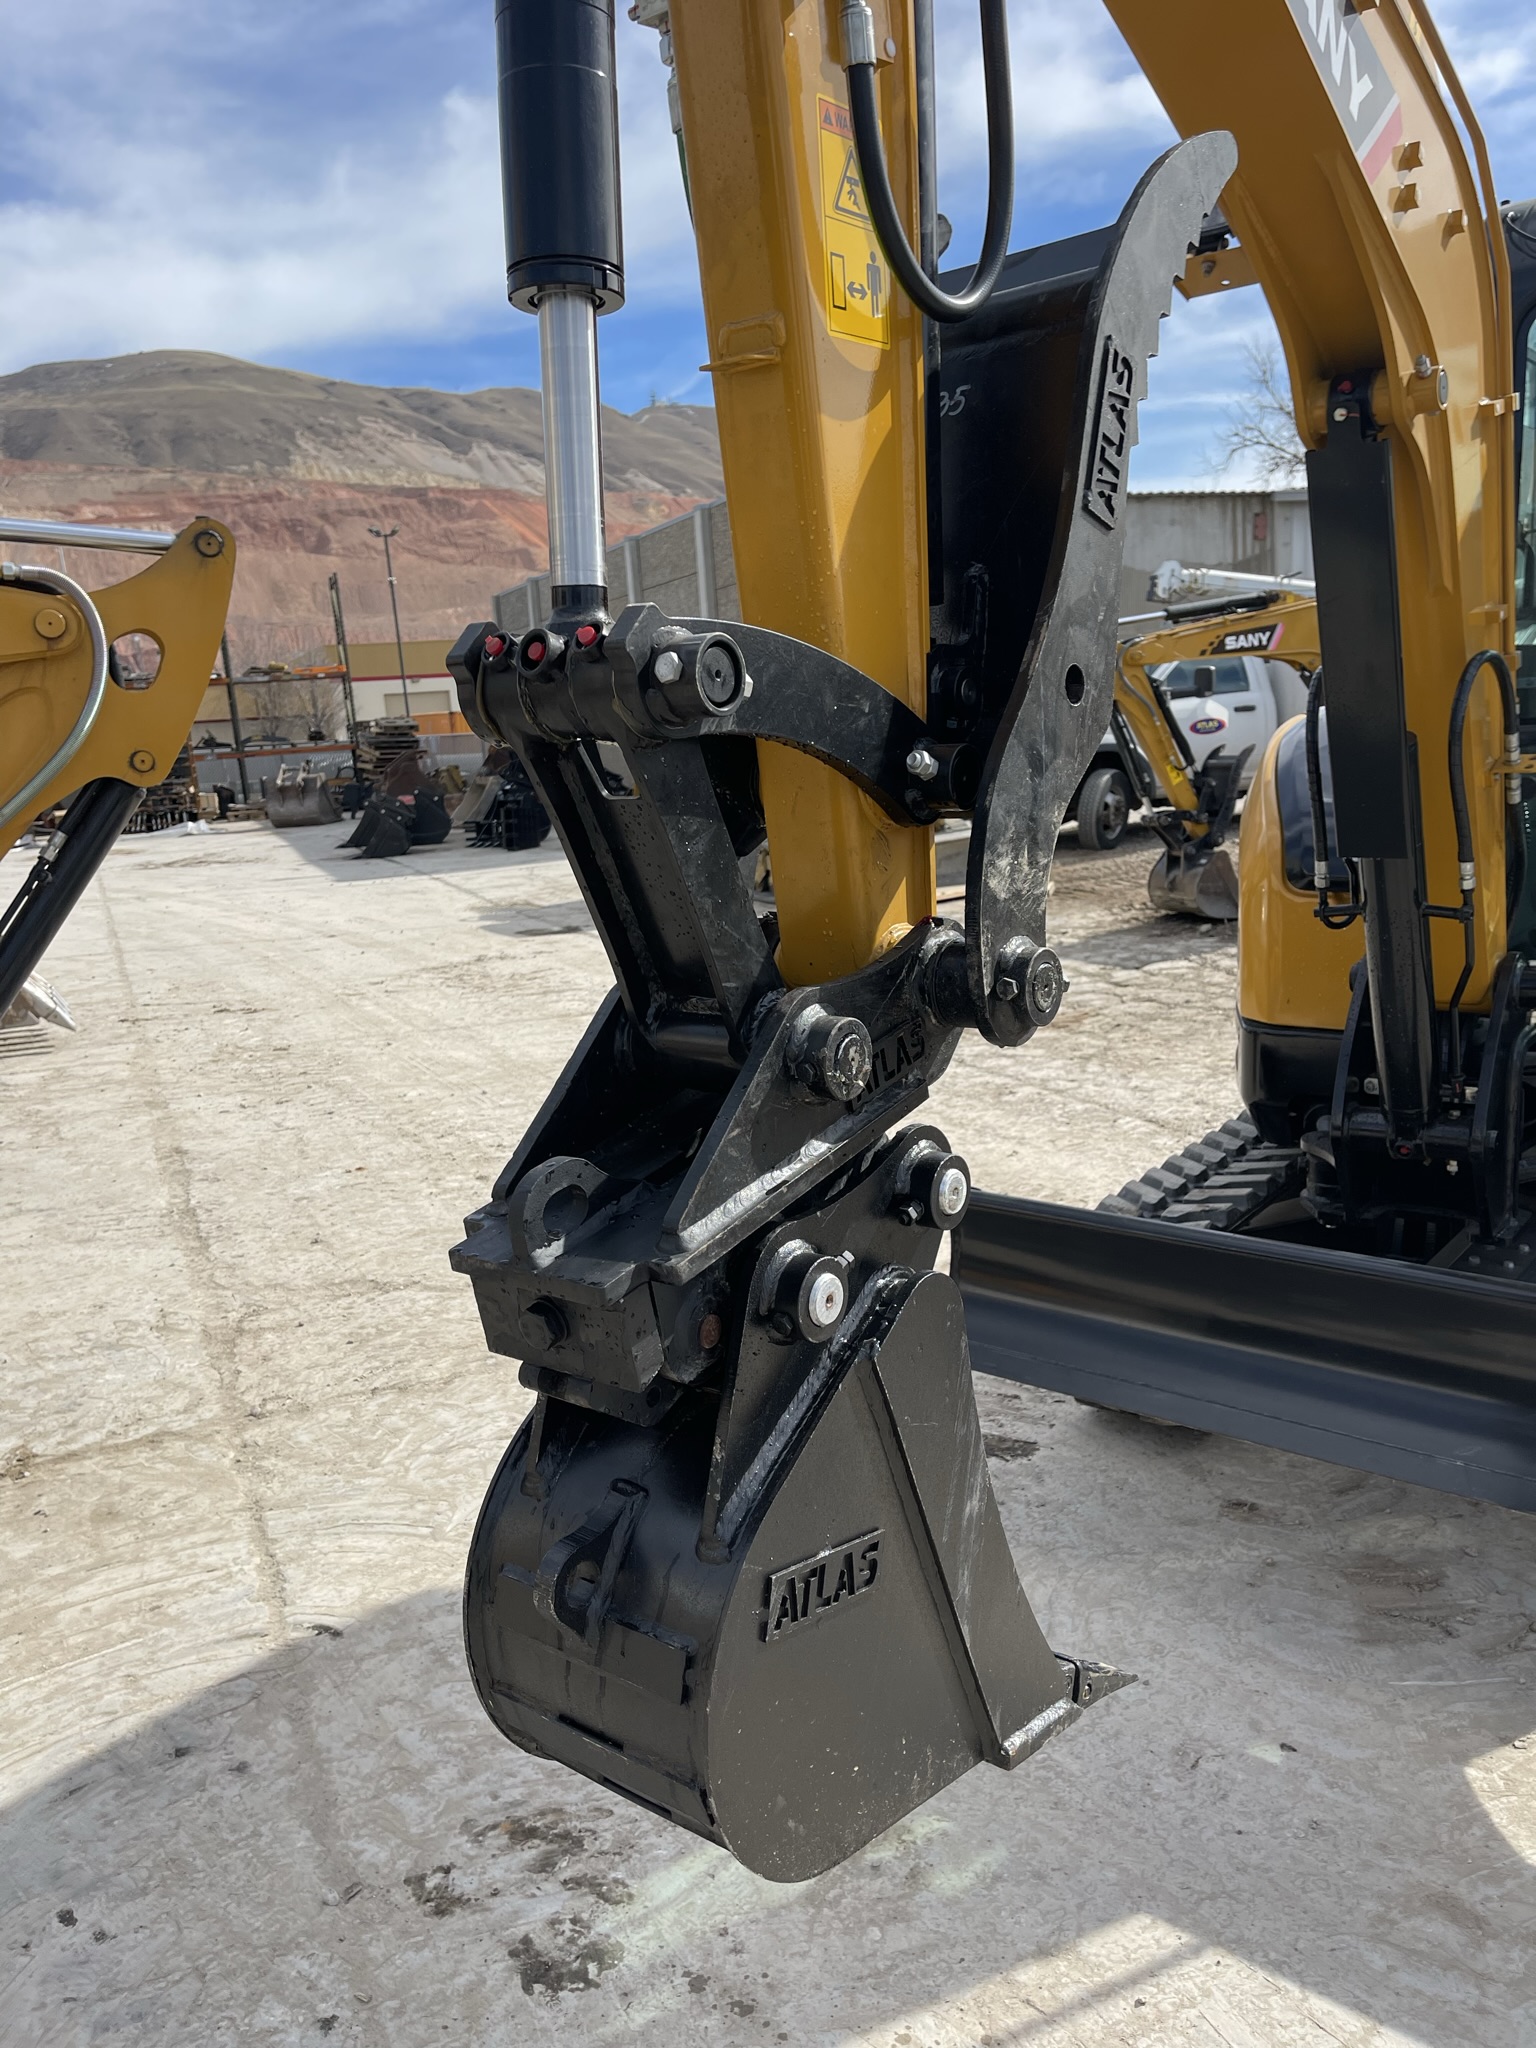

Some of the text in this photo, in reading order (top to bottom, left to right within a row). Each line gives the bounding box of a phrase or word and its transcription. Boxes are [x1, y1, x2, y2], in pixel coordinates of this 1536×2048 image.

[1095, 348, 1134, 518] ATLAS
[1224, 631, 1271, 650] SANY
[774, 1540, 880, 1631] ATLAS
